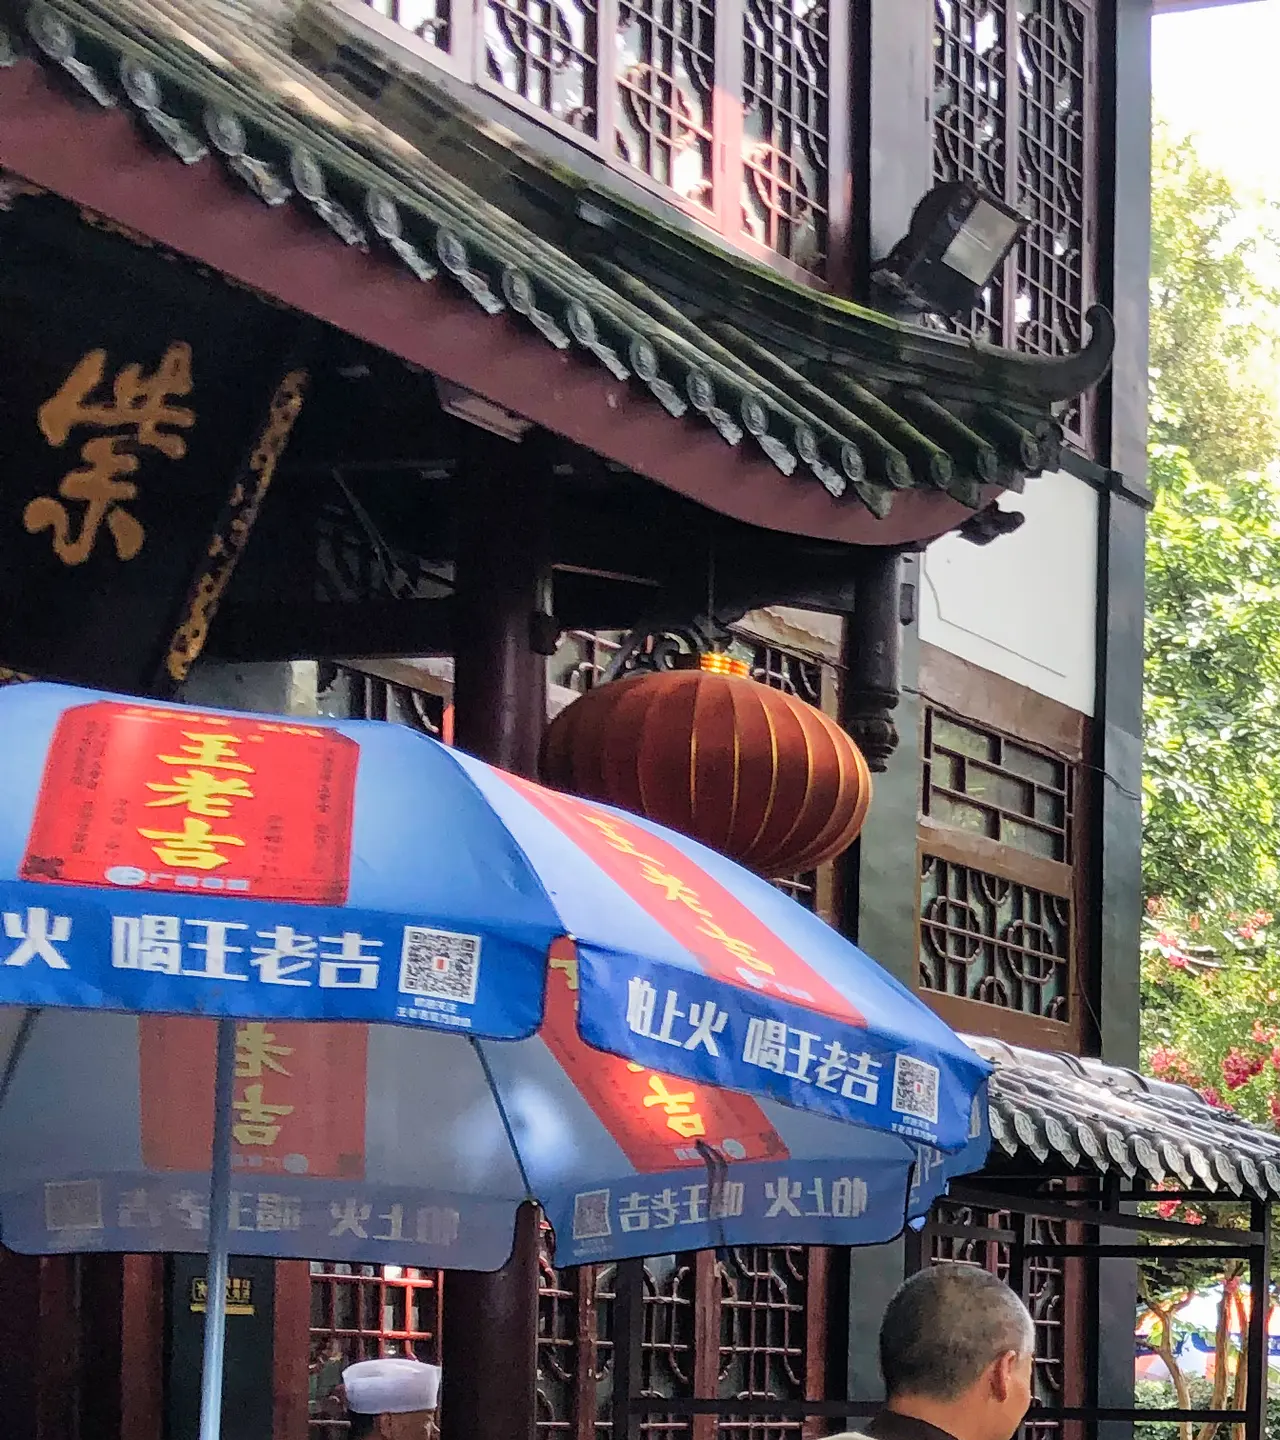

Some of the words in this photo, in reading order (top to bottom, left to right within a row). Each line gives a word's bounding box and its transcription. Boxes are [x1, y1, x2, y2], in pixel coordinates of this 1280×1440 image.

[137, 731, 256, 870] 王老吉
[111, 914, 385, 990] 喝王老吉
[627, 976, 729, 1058] 怕上火
[742, 1016, 883, 1107] 喝王老吉
